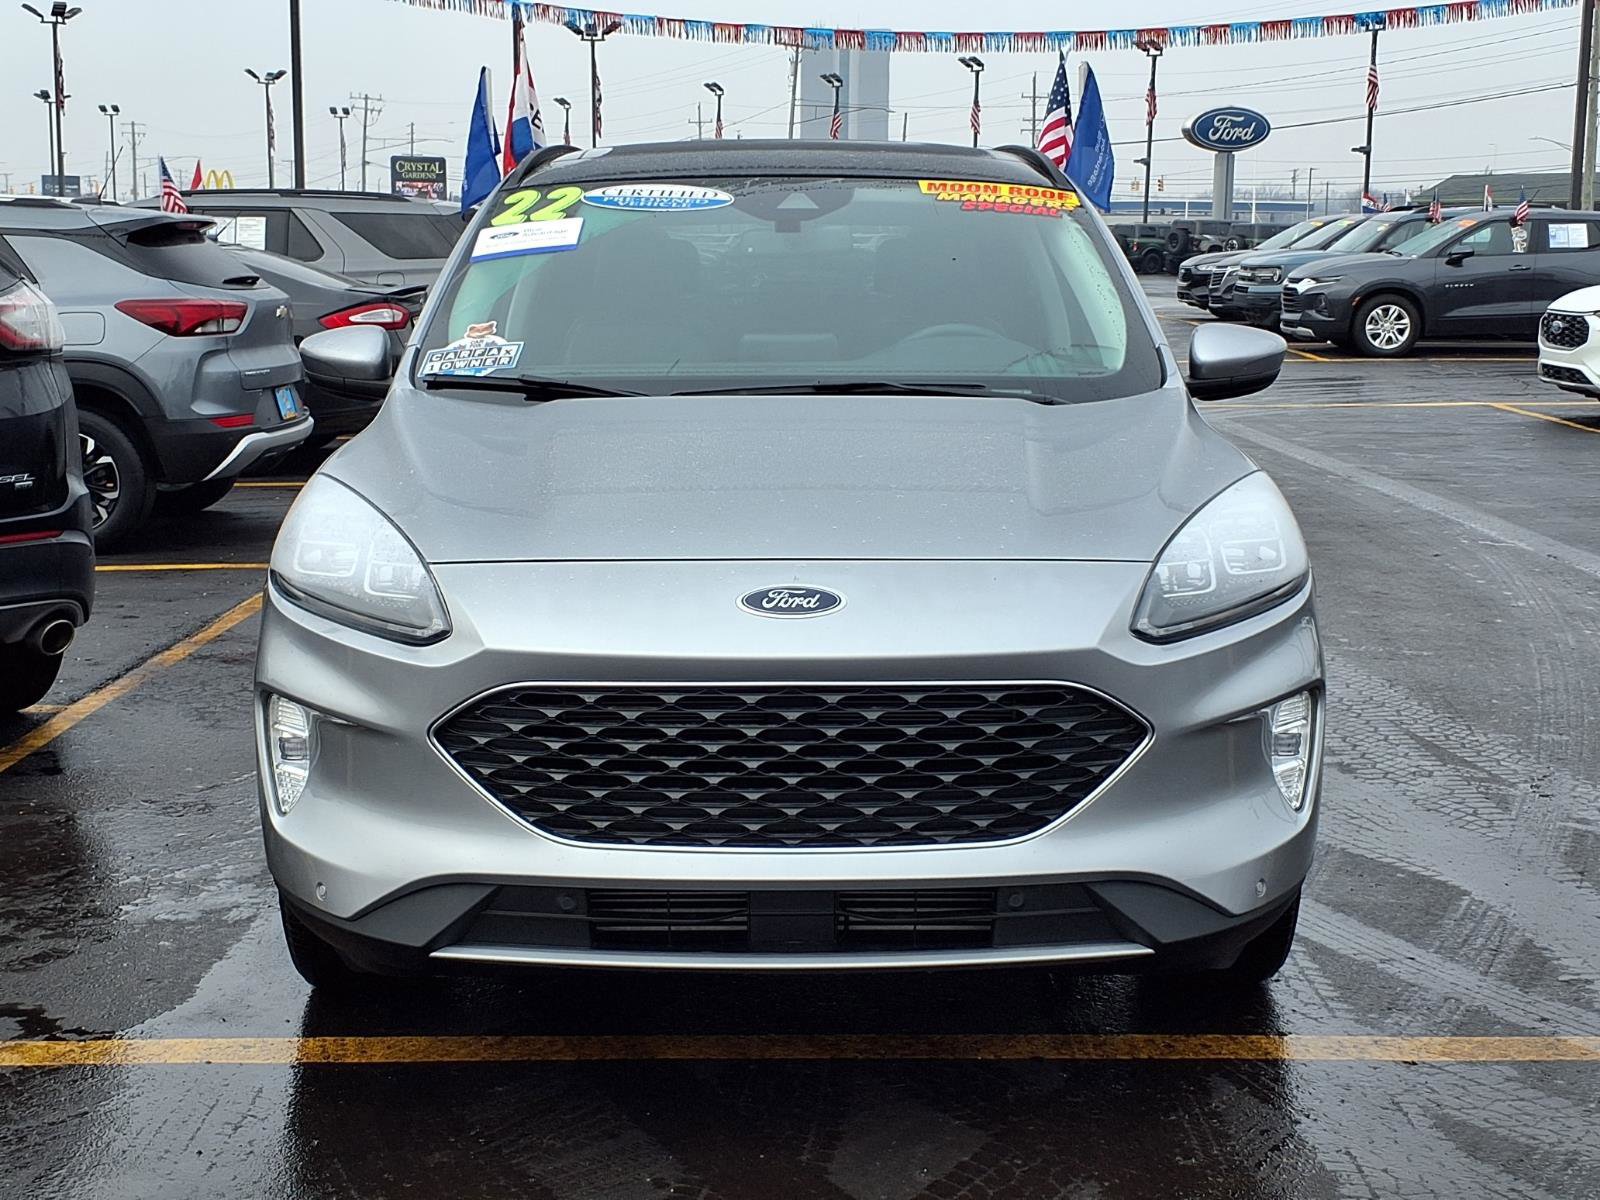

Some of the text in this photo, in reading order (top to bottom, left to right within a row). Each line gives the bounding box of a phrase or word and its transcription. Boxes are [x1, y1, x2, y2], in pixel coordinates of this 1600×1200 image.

[1208, 115, 1256, 141] Ford
[396, 160, 444, 173] CRYSTAL
[601, 187, 719, 198] CERTIFIED
[927, 182, 1073, 201] MOON ROOF
[490, 186, 585, 226] 22
[961, 200, 1062, 217] SPECIAL
[431, 347, 513, 361] CARFAX
[440, 357, 512, 371] OWNER
[761, 589, 821, 608] Ford
